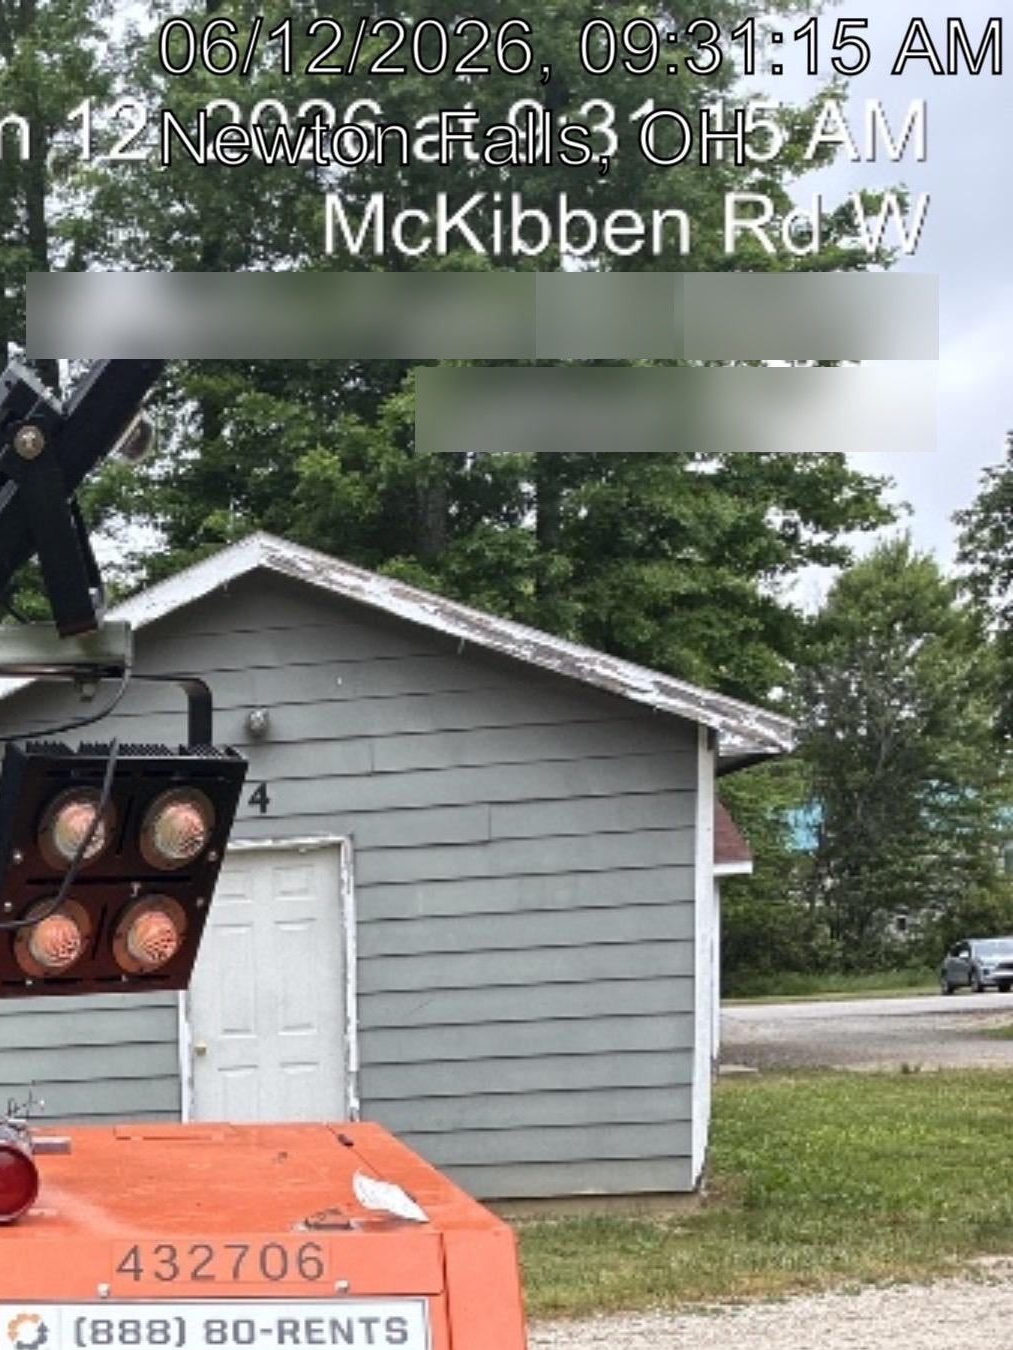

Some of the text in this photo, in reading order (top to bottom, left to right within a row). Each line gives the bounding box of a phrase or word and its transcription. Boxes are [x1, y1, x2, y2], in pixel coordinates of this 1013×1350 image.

[248, 781, 270, 814] 4
[116, 1243, 325, 1281] 432706
[203, 1316, 408, 1345] 80-RENTS
